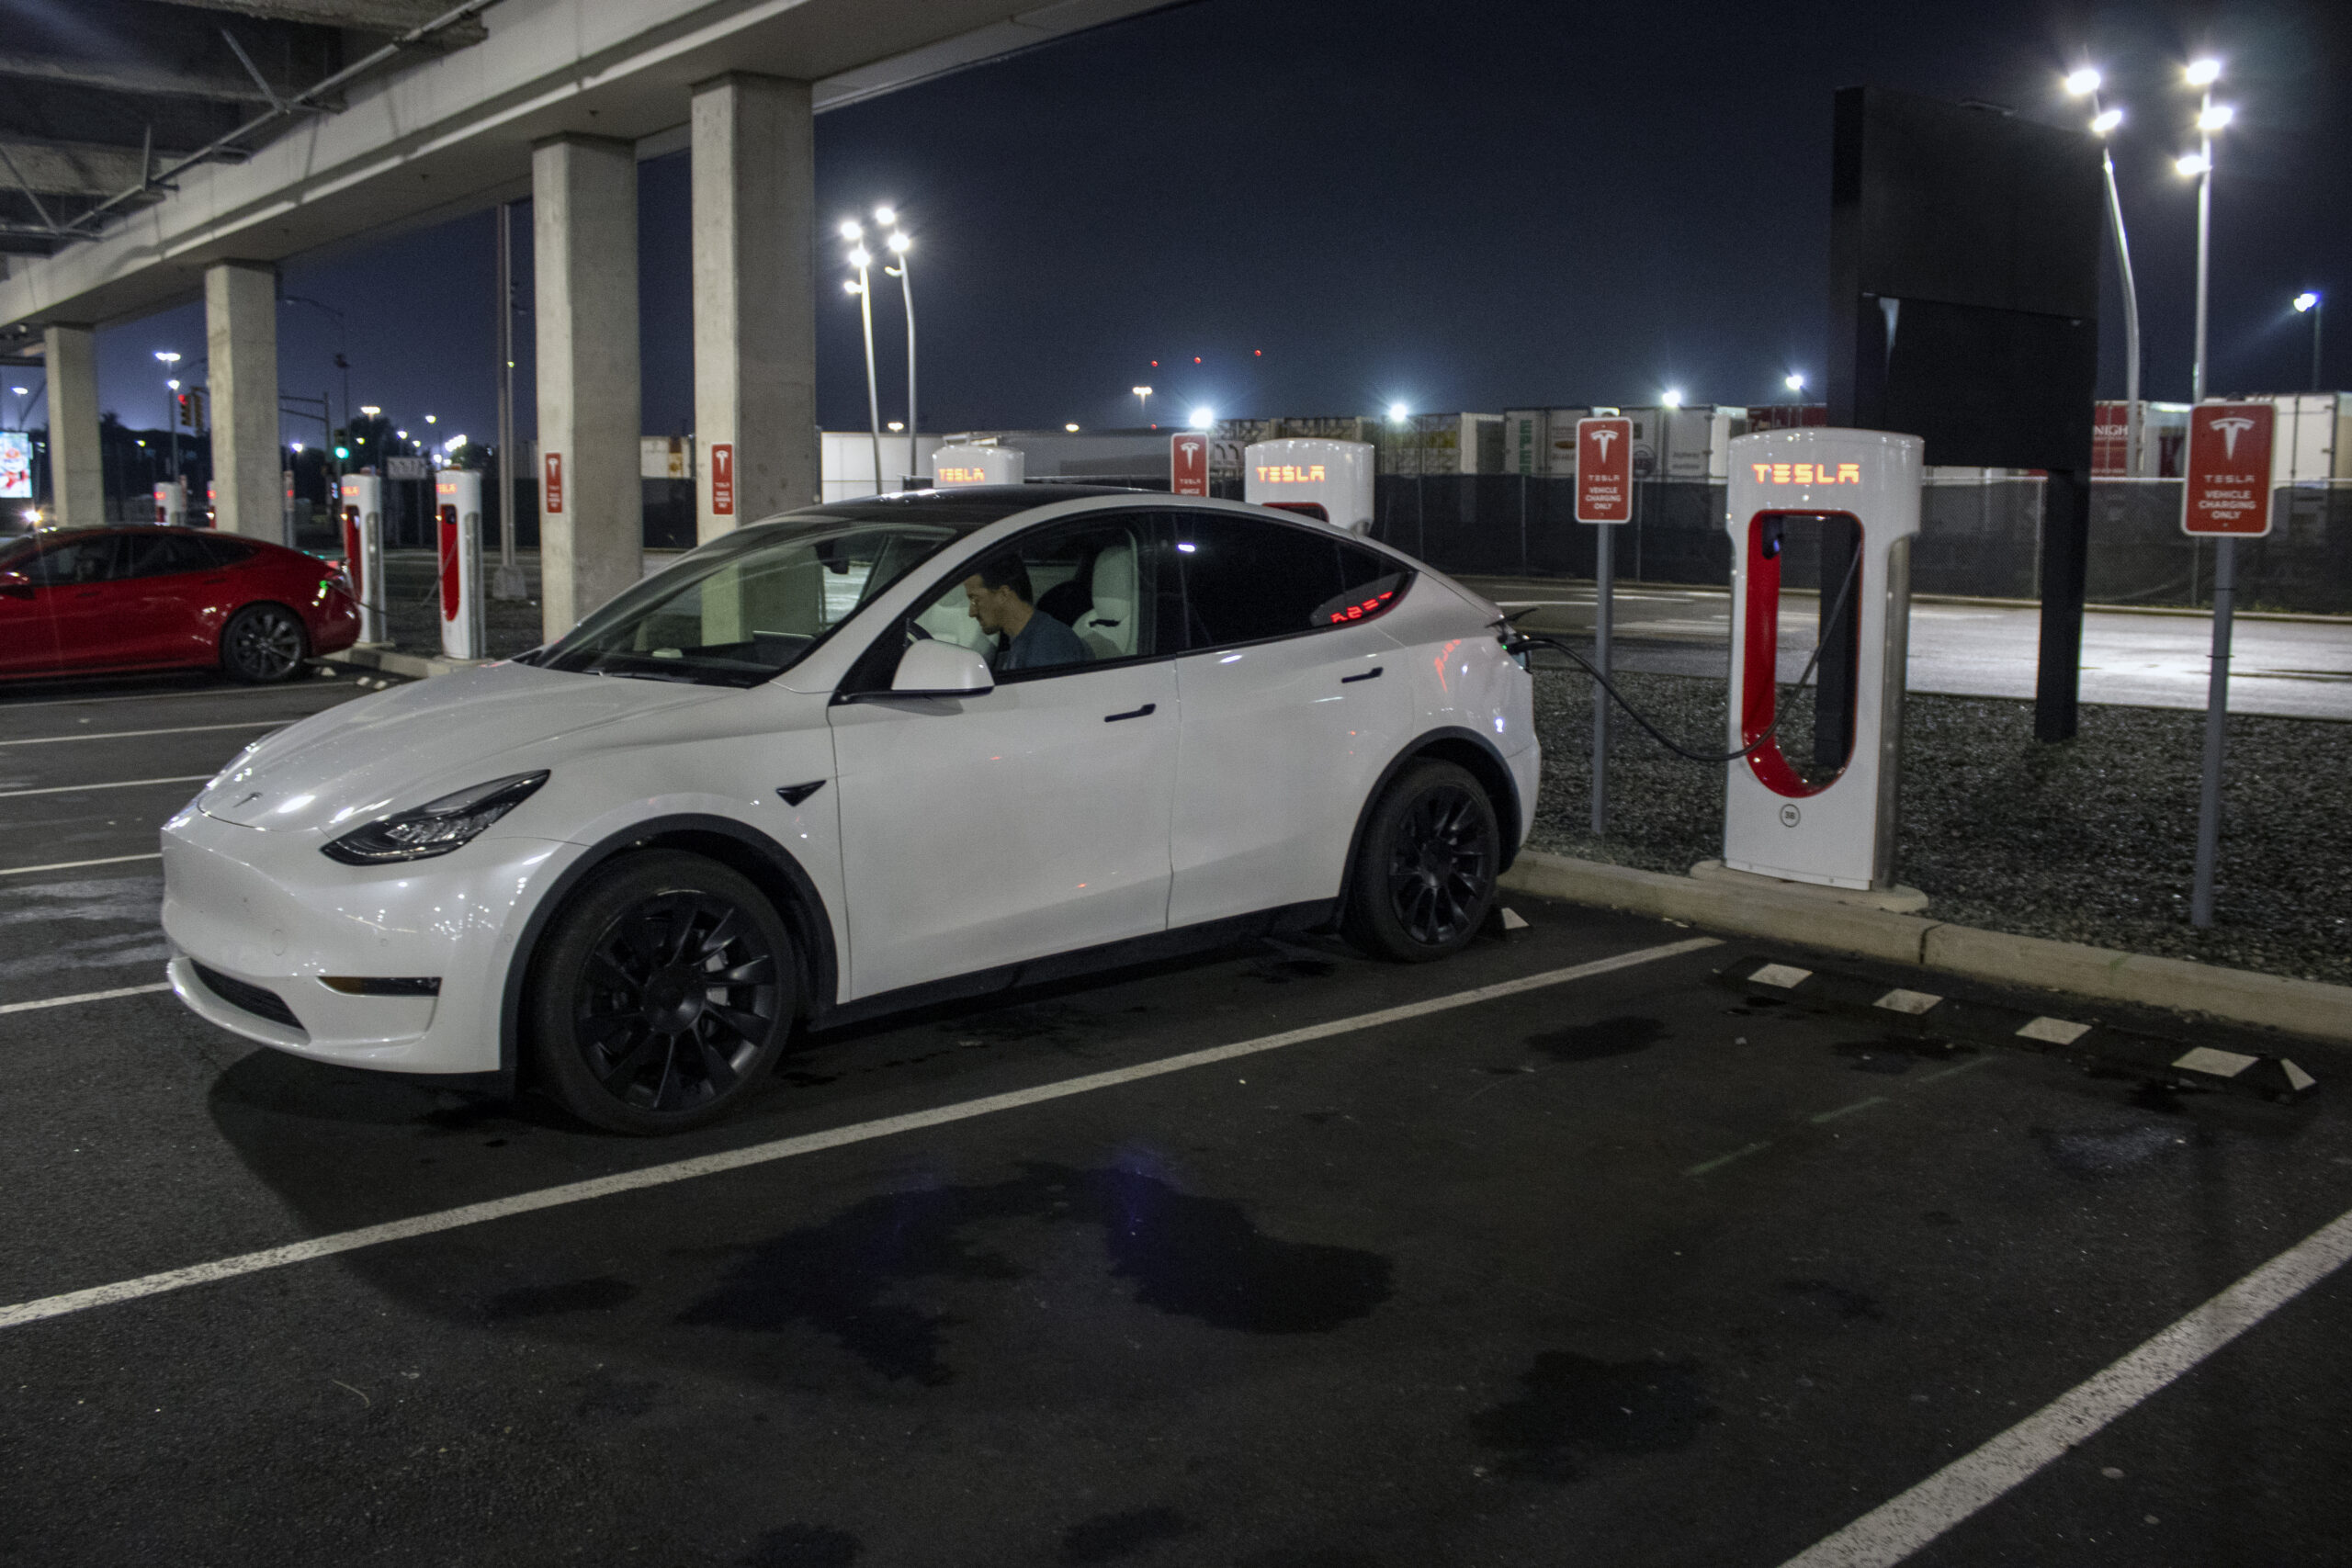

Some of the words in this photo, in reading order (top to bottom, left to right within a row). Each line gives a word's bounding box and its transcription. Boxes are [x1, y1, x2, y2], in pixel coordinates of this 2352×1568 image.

[938, 467, 985, 482] TESLA
[1256, 465, 1325, 483] TESLA
[1750, 463, 1860, 485] TESLA
[2203, 474, 2256, 483] TESLA
[2205, 490, 2252, 500] VEHICLE
[2198, 500, 2256, 510] CHARGING
[2211, 510, 2242, 520] ONLY
